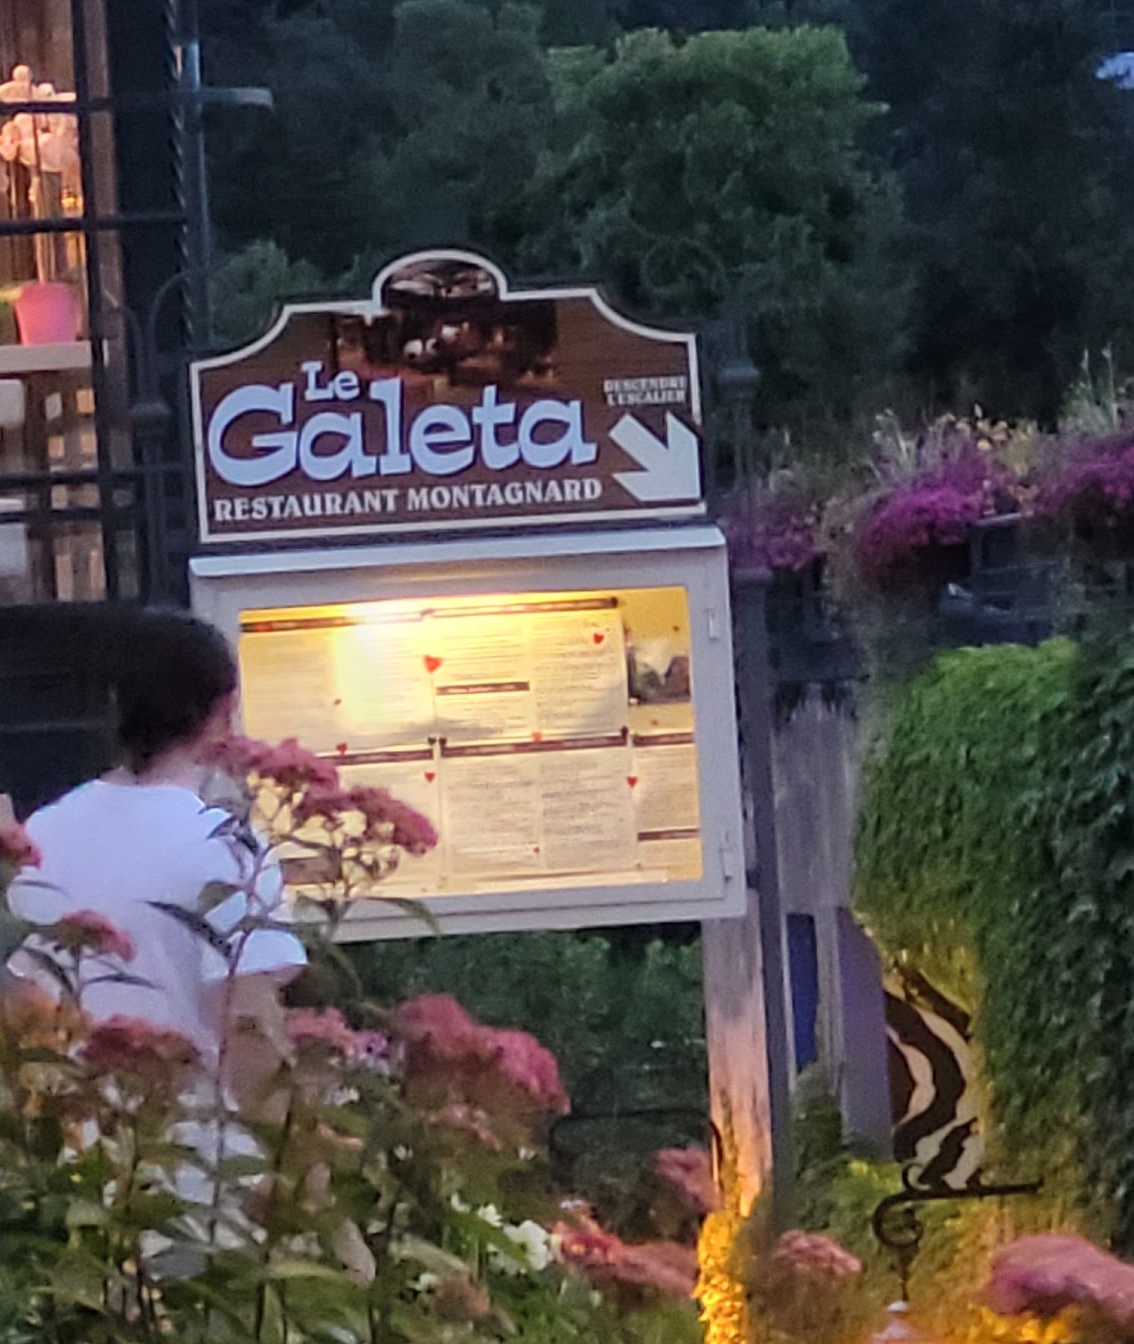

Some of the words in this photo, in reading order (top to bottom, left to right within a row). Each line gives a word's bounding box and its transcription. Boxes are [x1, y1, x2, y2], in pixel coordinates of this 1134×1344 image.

[302, 360, 359, 401] Le
[208, 377, 597, 486] Galeta
[214, 487, 397, 522] RESTAURANT
[407, 477, 603, 511] MONTAGNARD
